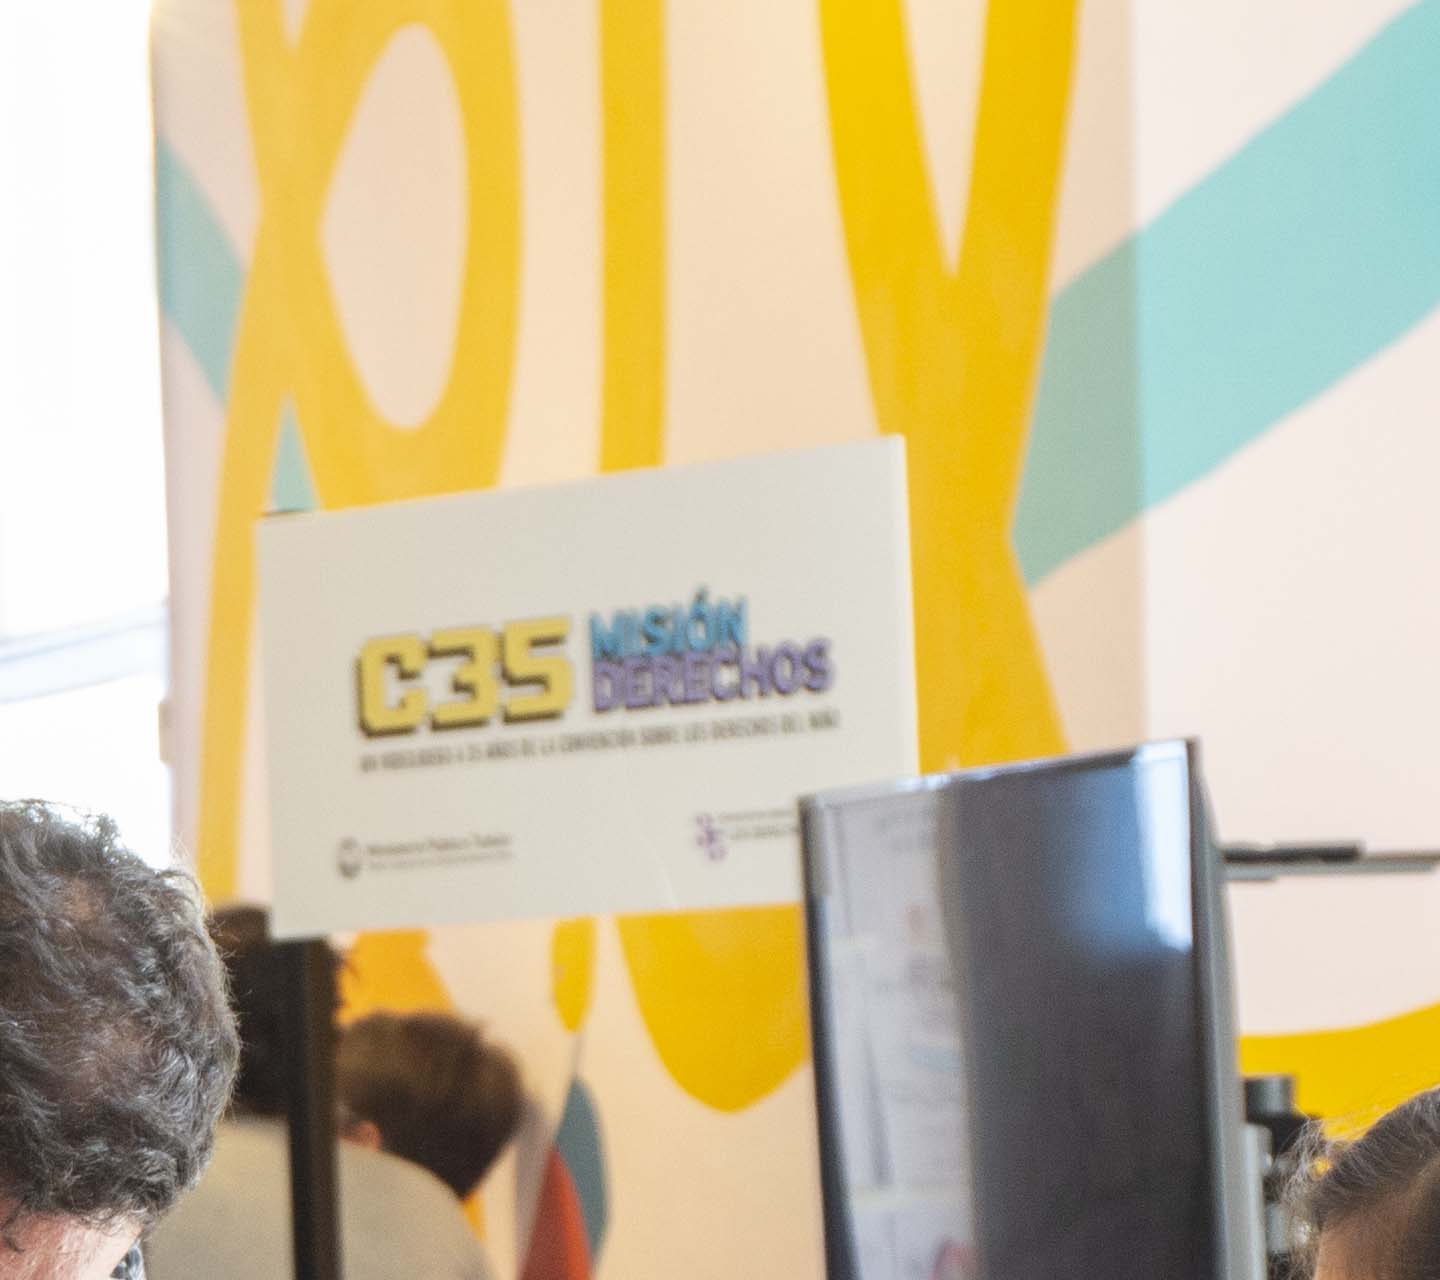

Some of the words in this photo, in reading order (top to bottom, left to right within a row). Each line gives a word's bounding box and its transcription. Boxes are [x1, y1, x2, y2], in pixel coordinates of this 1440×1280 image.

[589, 587, 747, 657] MISIÓN
[357, 619, 573, 737] C35
[591, 638, 833, 713] DERECHOS
